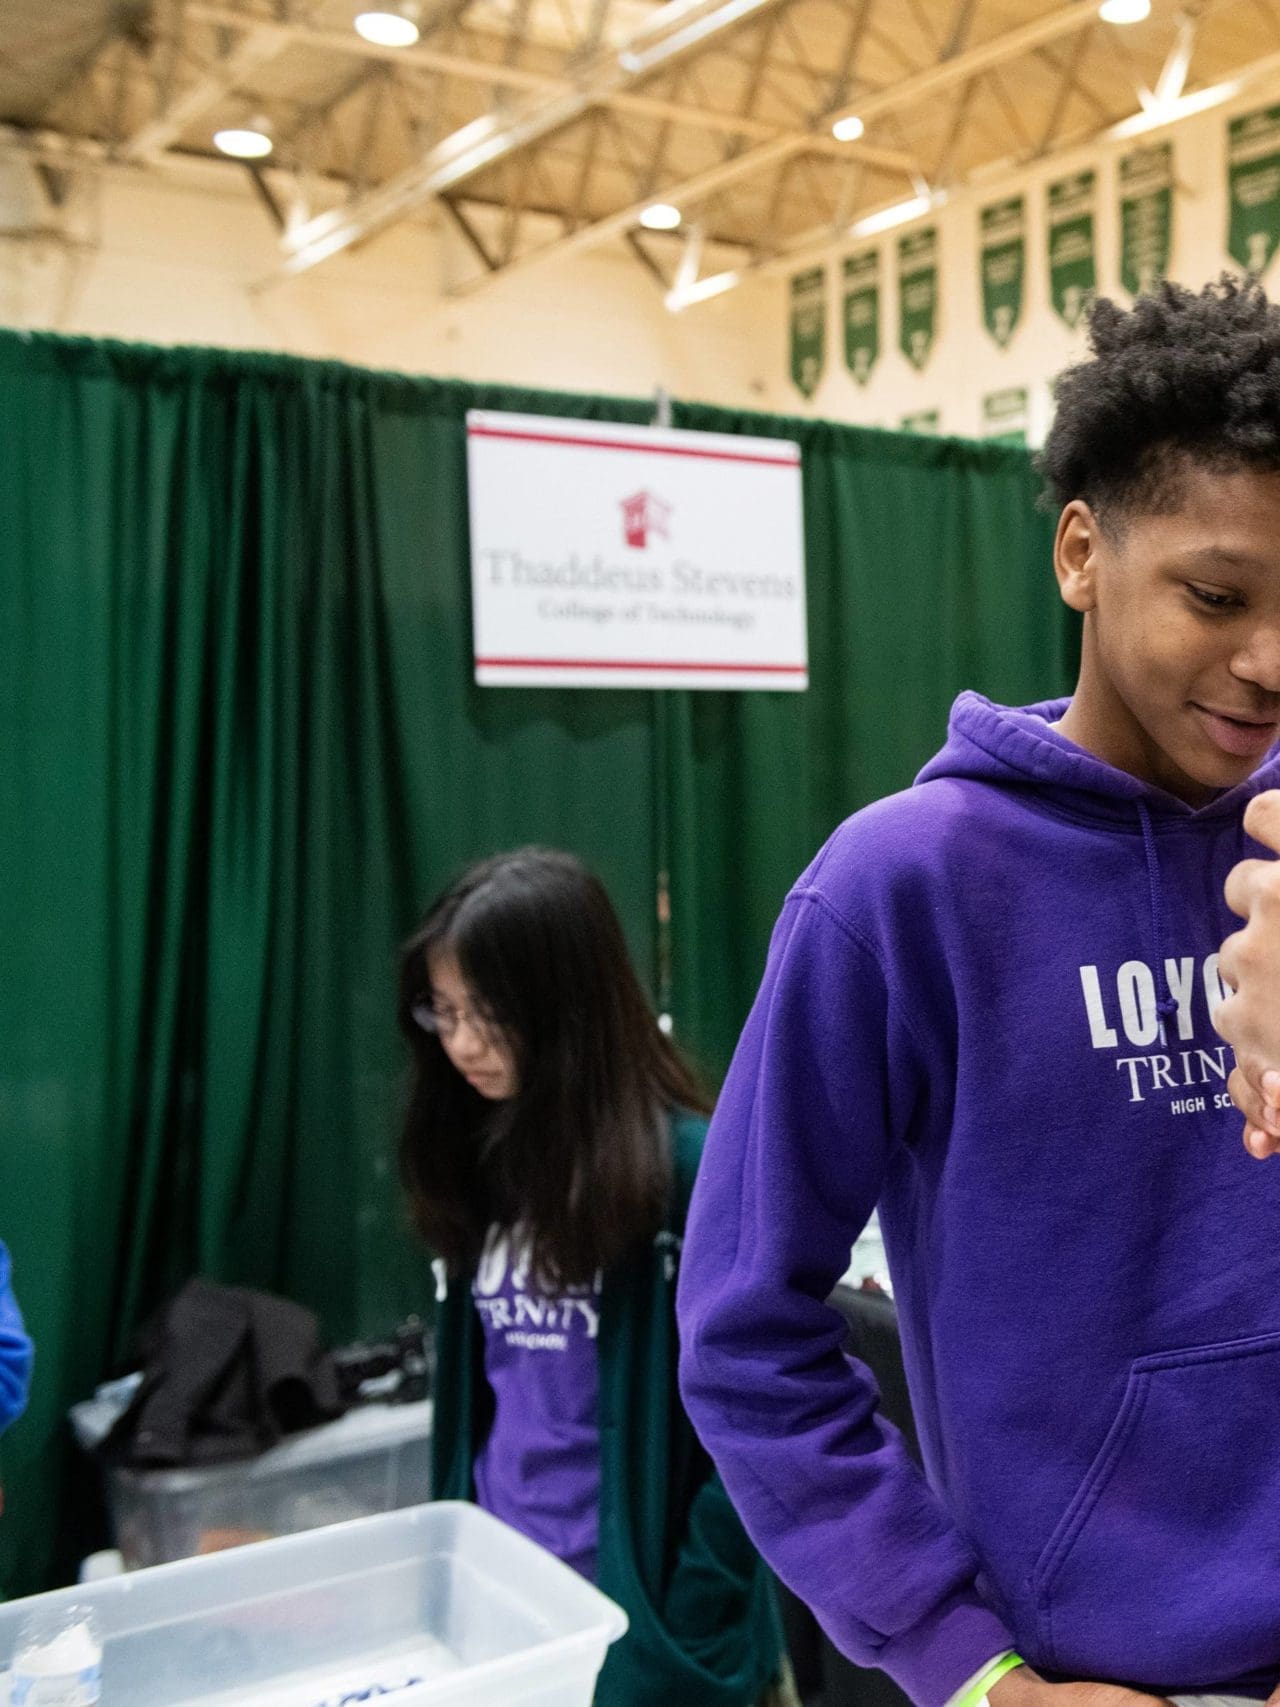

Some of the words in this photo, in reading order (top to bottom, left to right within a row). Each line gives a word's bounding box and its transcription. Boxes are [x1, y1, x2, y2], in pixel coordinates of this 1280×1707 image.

[484, 548, 664, 592] Thaddeus
[670, 557, 797, 602] Stevens
[537, 599, 614, 627] College
[621, 602, 640, 620] of
[646, 602, 757, 630] Technology
[1171, 1097, 1206, 1115] HIGH
